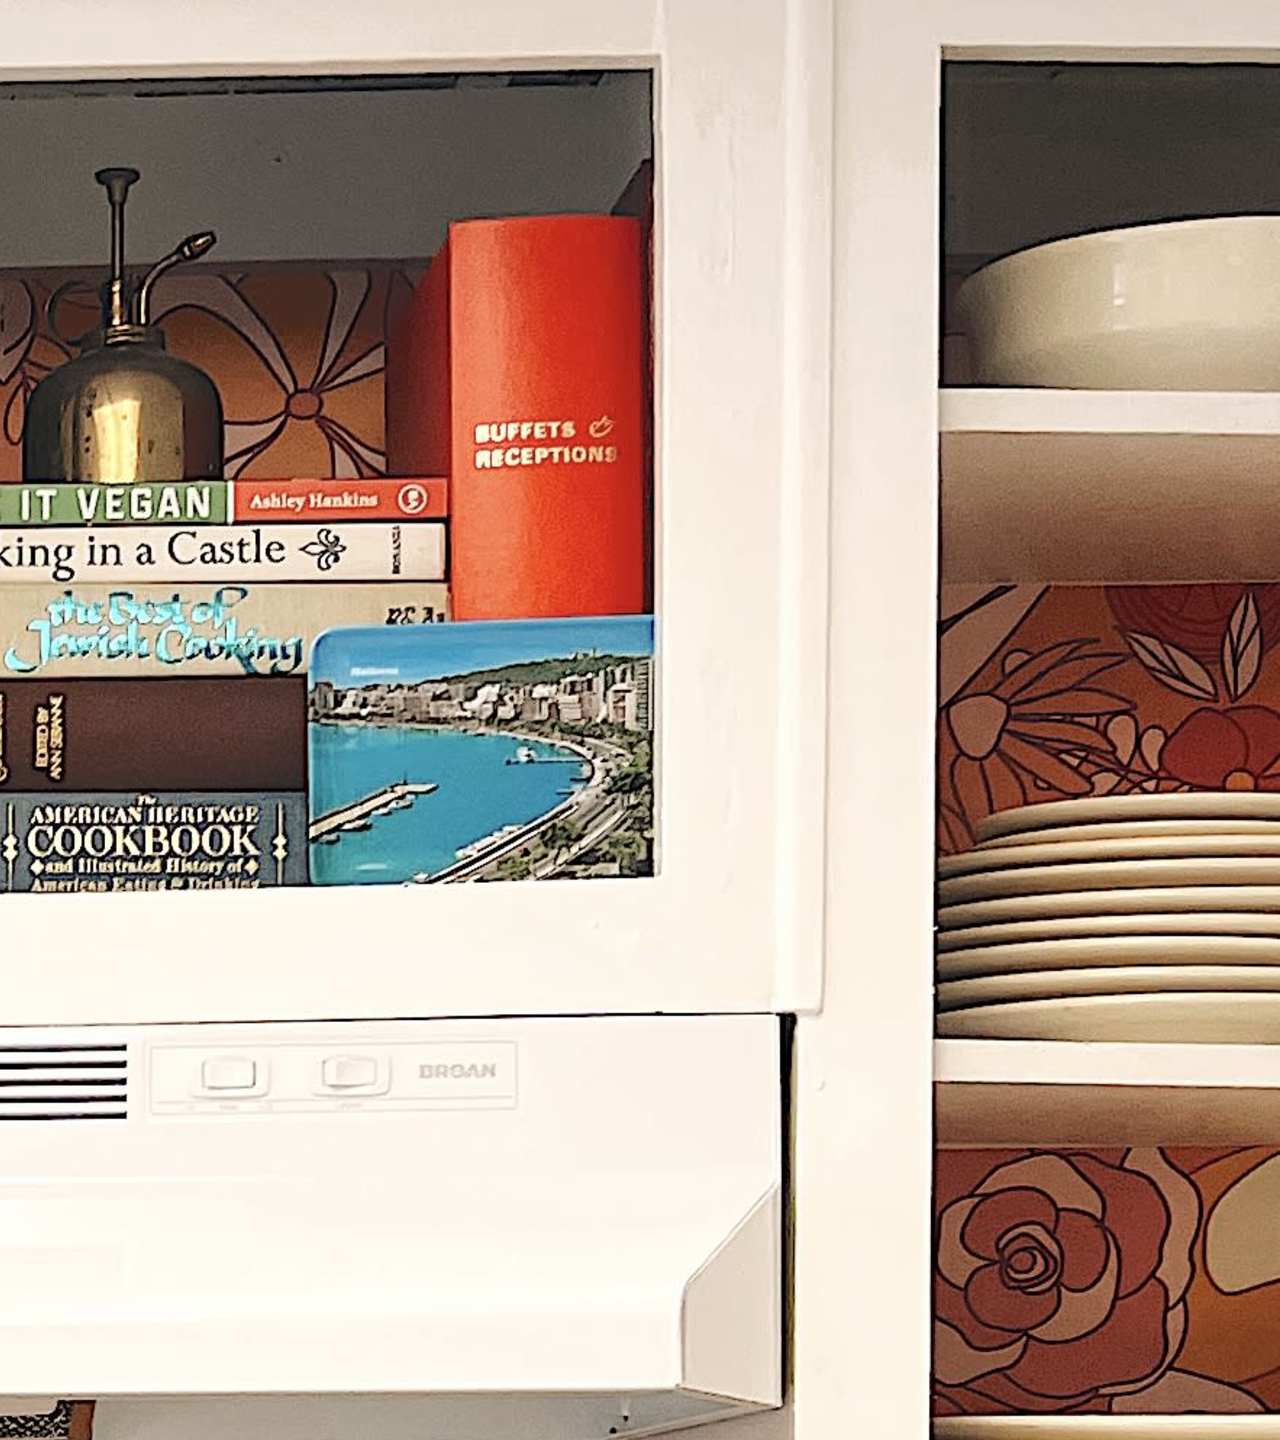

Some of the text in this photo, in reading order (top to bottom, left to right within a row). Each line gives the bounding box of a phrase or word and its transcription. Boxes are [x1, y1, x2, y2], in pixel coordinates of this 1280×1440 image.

[474, 421, 576, 444] BUFFETS
[474, 446, 617, 469] RECEPTIONS
[20, 489, 57, 521] IT
[78, 486, 212, 520] VEGAN
[250, 492, 378, 512] Ashley Hankins
[86, 533, 122, 567] in
[135, 544, 156, 566] a
[167, 530, 287, 565] Castle
[109, 591, 186, 625] Best
[191, 586, 248, 629] of
[4, 617, 302, 675] Jewish Cooking
[30, 806, 259, 824] AMERICAN HERITAGE
[27, 825, 260, 857] COOKBOOK
[45, 859, 74, 873] and
[78, 858, 162, 874] Illustrated
[166, 858, 224, 875] History
[418, 1062, 497, 1080] BROAN
